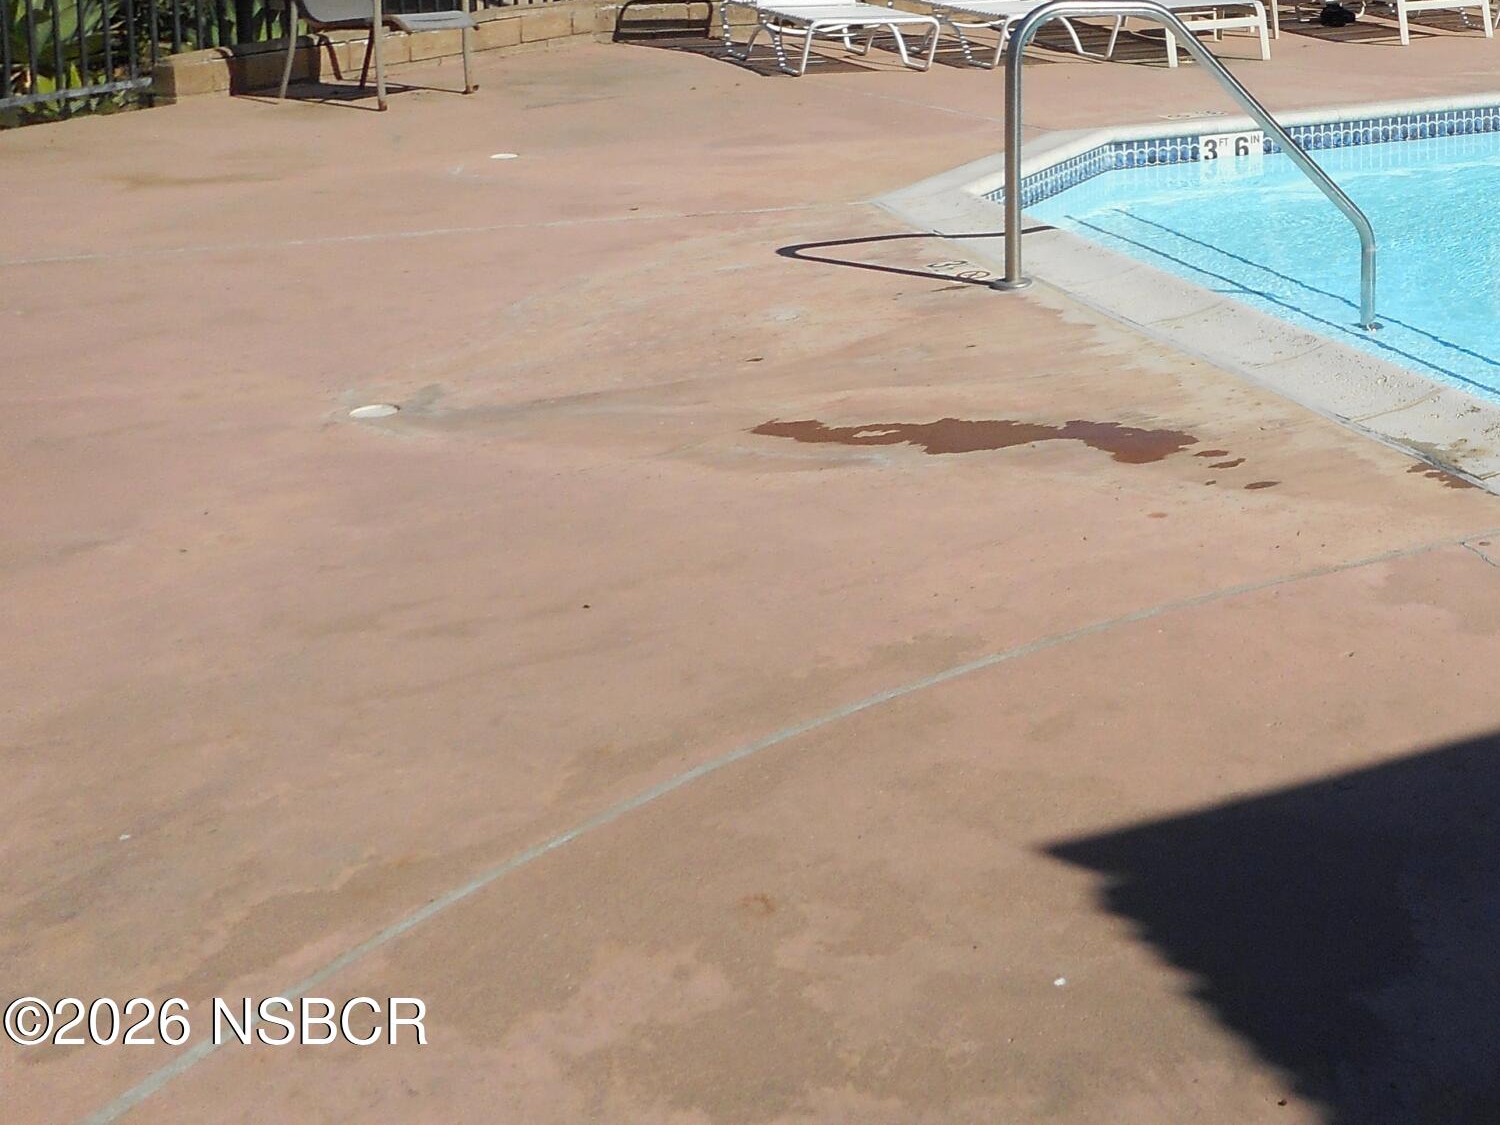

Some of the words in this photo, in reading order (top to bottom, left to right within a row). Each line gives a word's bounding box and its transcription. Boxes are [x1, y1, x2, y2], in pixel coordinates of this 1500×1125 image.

[1203, 139, 1219, 160] 3
[1219, 137, 1229, 147] FT
[1234, 136, 1249, 157] 6
[1250, 134, 1260, 144] IN
